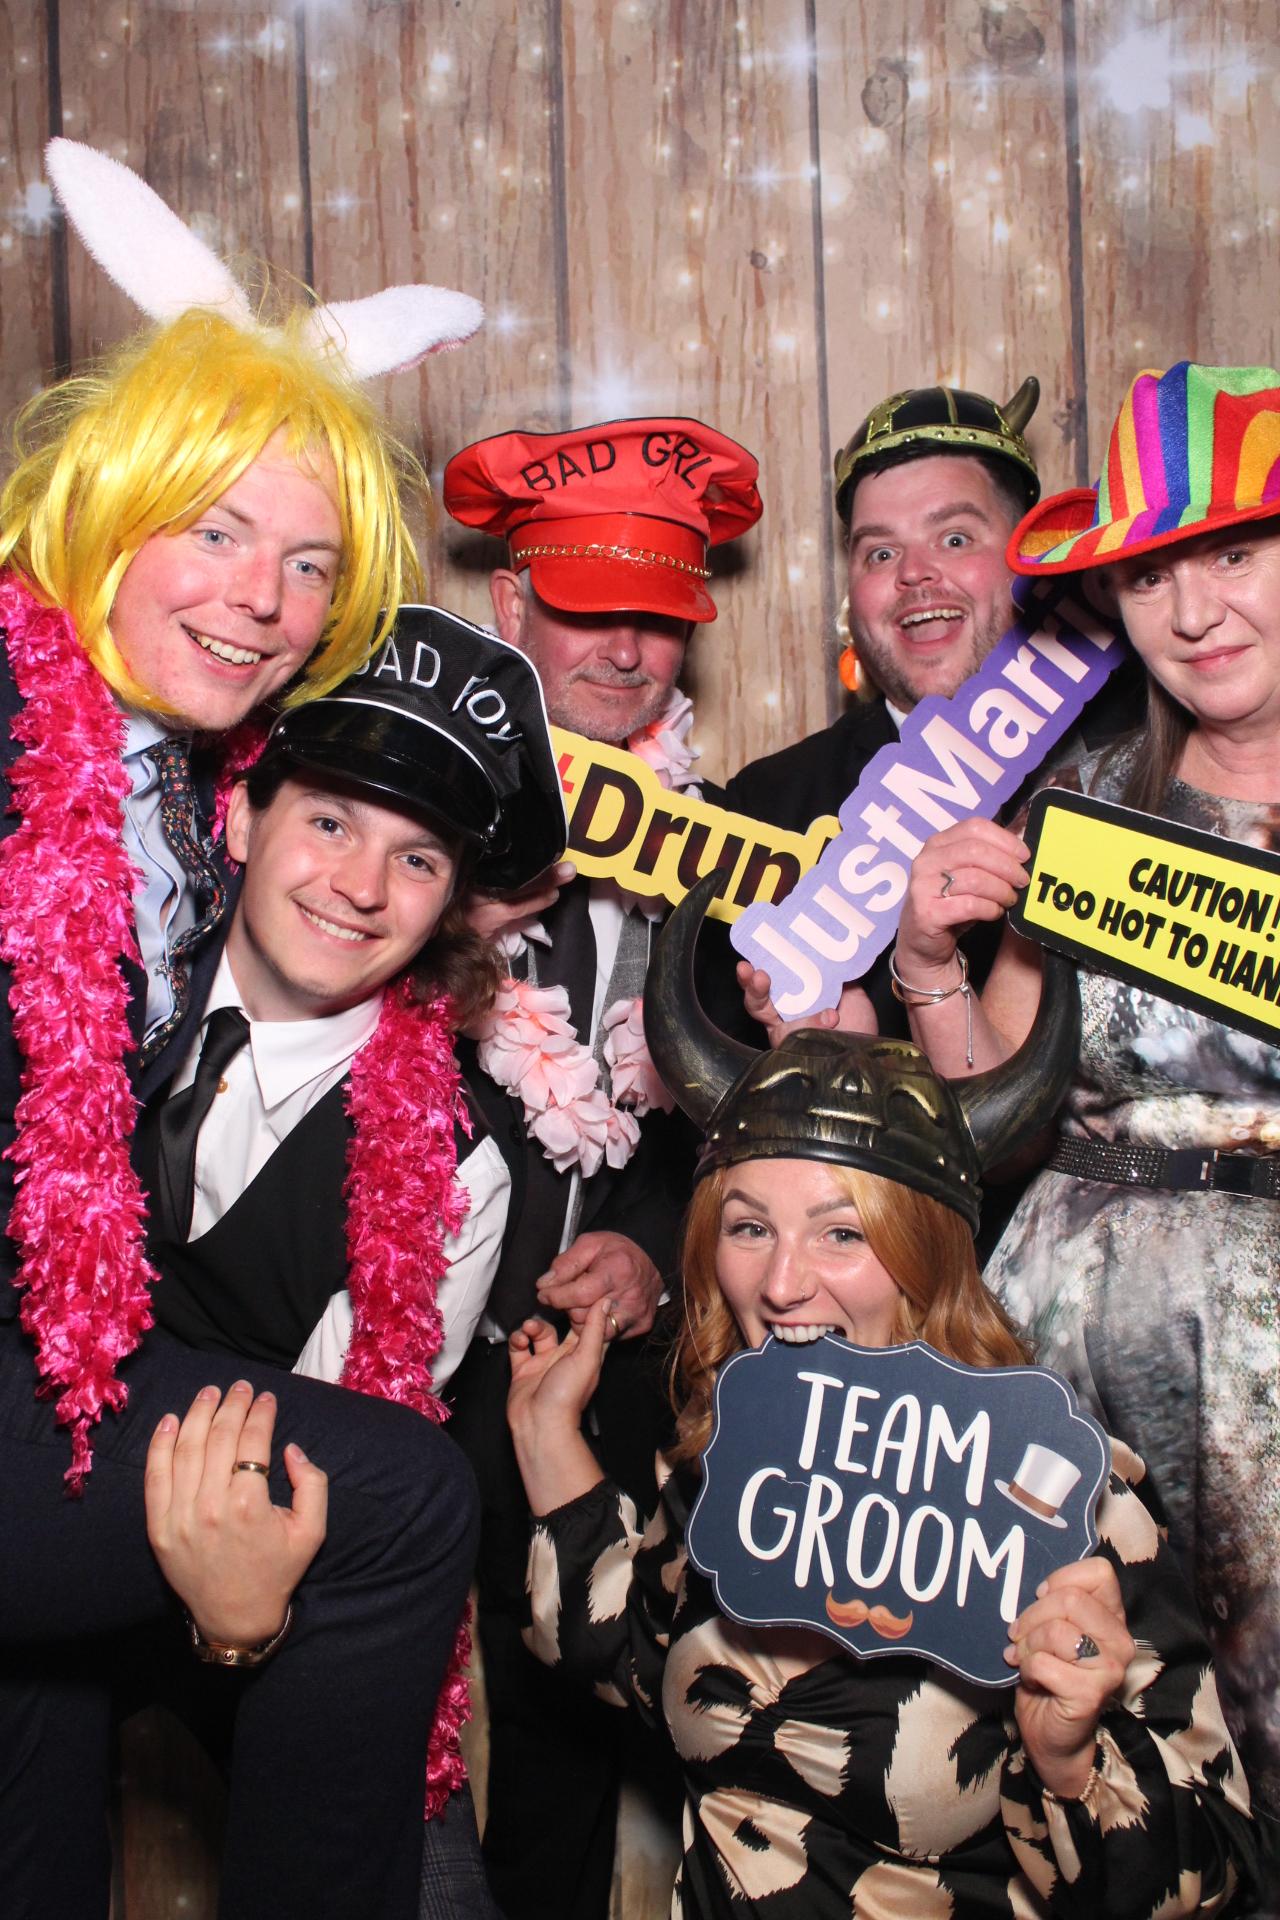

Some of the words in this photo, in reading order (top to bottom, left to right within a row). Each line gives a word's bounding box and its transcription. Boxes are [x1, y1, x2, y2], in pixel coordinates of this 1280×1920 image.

[520, 440, 616, 491] BAD
[642, 431, 712, 490] GRL
[557, 752, 832, 909] Drun
[1037, 872, 1096, 921] TOO
[1097, 897, 1167, 950] HOT
[1167, 921, 1209, 969] TO
[1208, 939, 1280, 1008] HAN
[797, 1371, 990, 1506] TEAM
[737, 1466, 1025, 1624] GROOM
